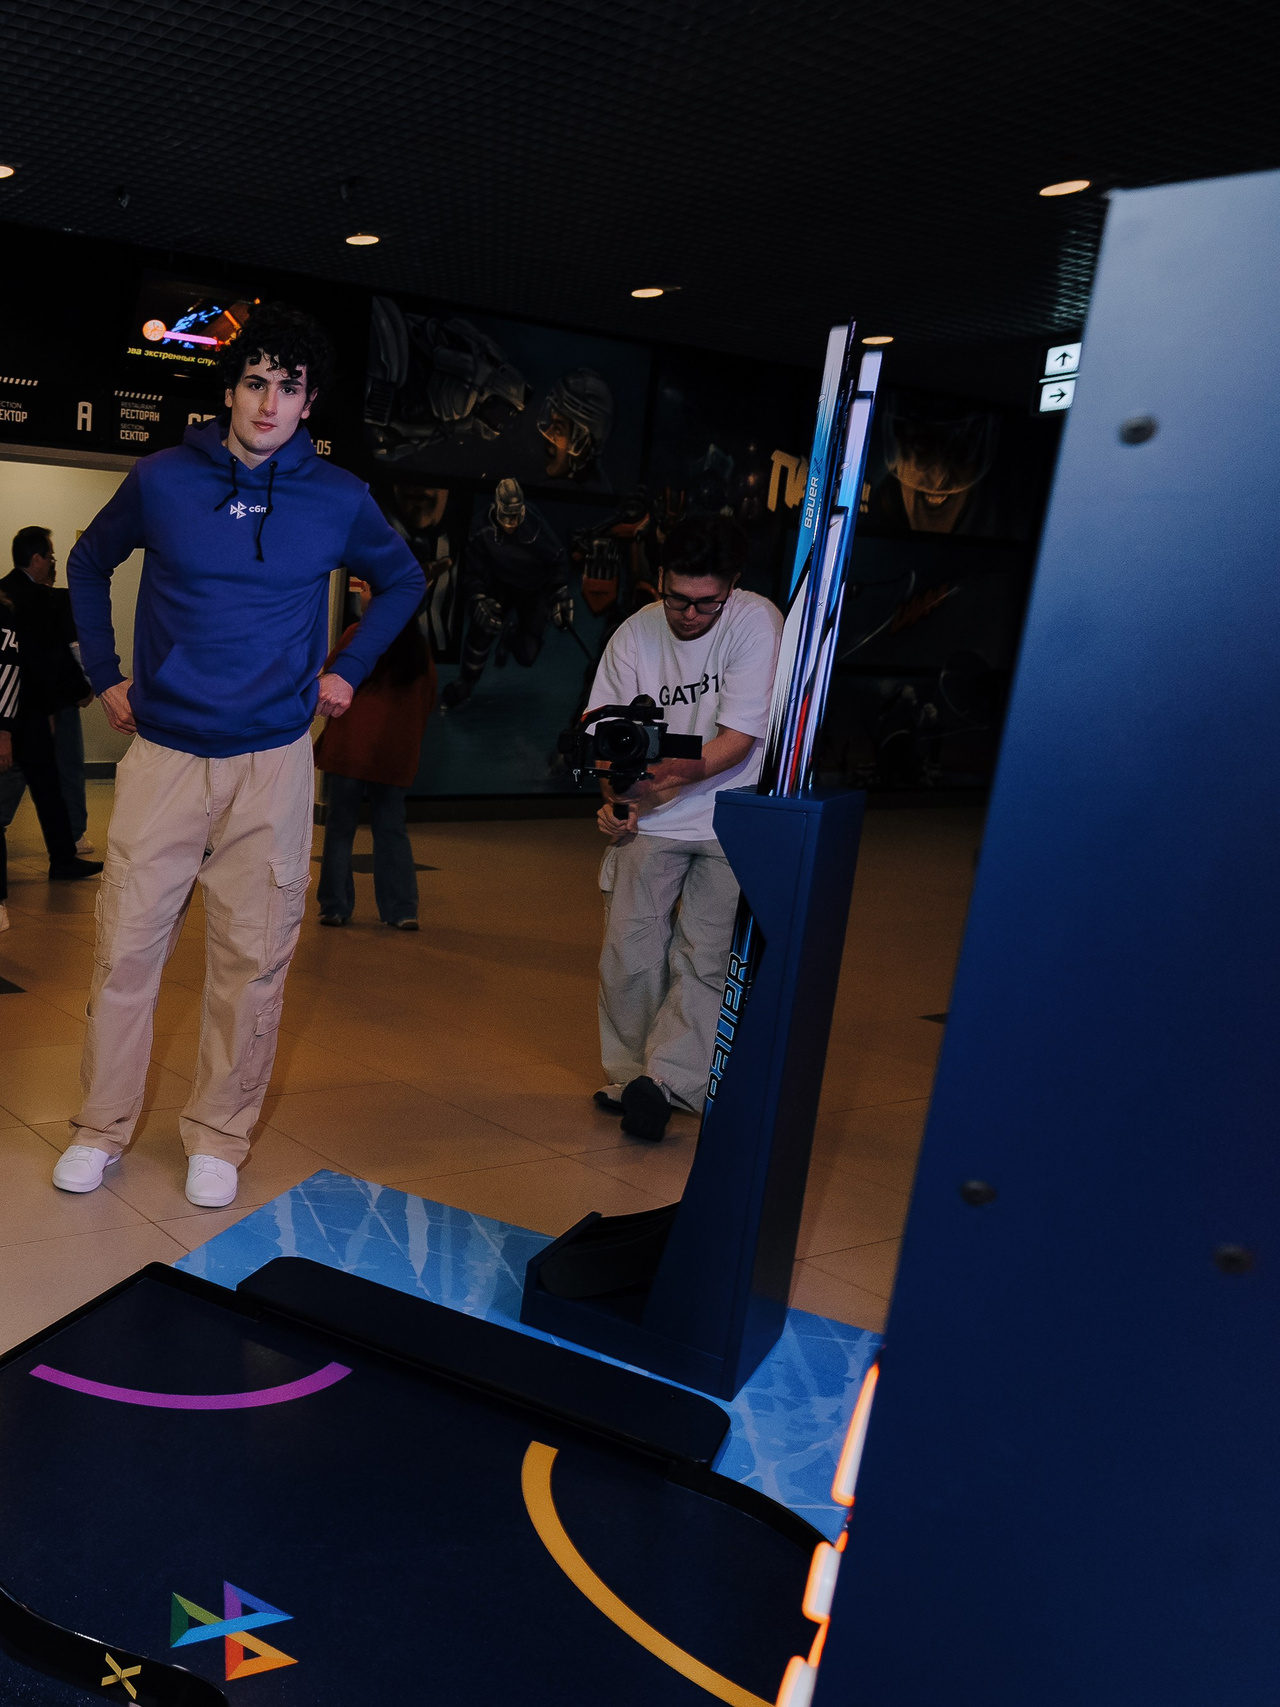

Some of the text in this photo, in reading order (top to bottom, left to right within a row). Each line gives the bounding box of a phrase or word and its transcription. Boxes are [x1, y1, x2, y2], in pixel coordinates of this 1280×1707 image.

[144, 349, 196, 362] экстренных
[120, 401, 157, 410] RESTAURANT
[120, 408, 160, 422] РЕСТОРАН
[120, 423, 145, 431] SECTION
[120, 430, 150, 442] СЕКТОР
[0, 628, 20, 654] 74
